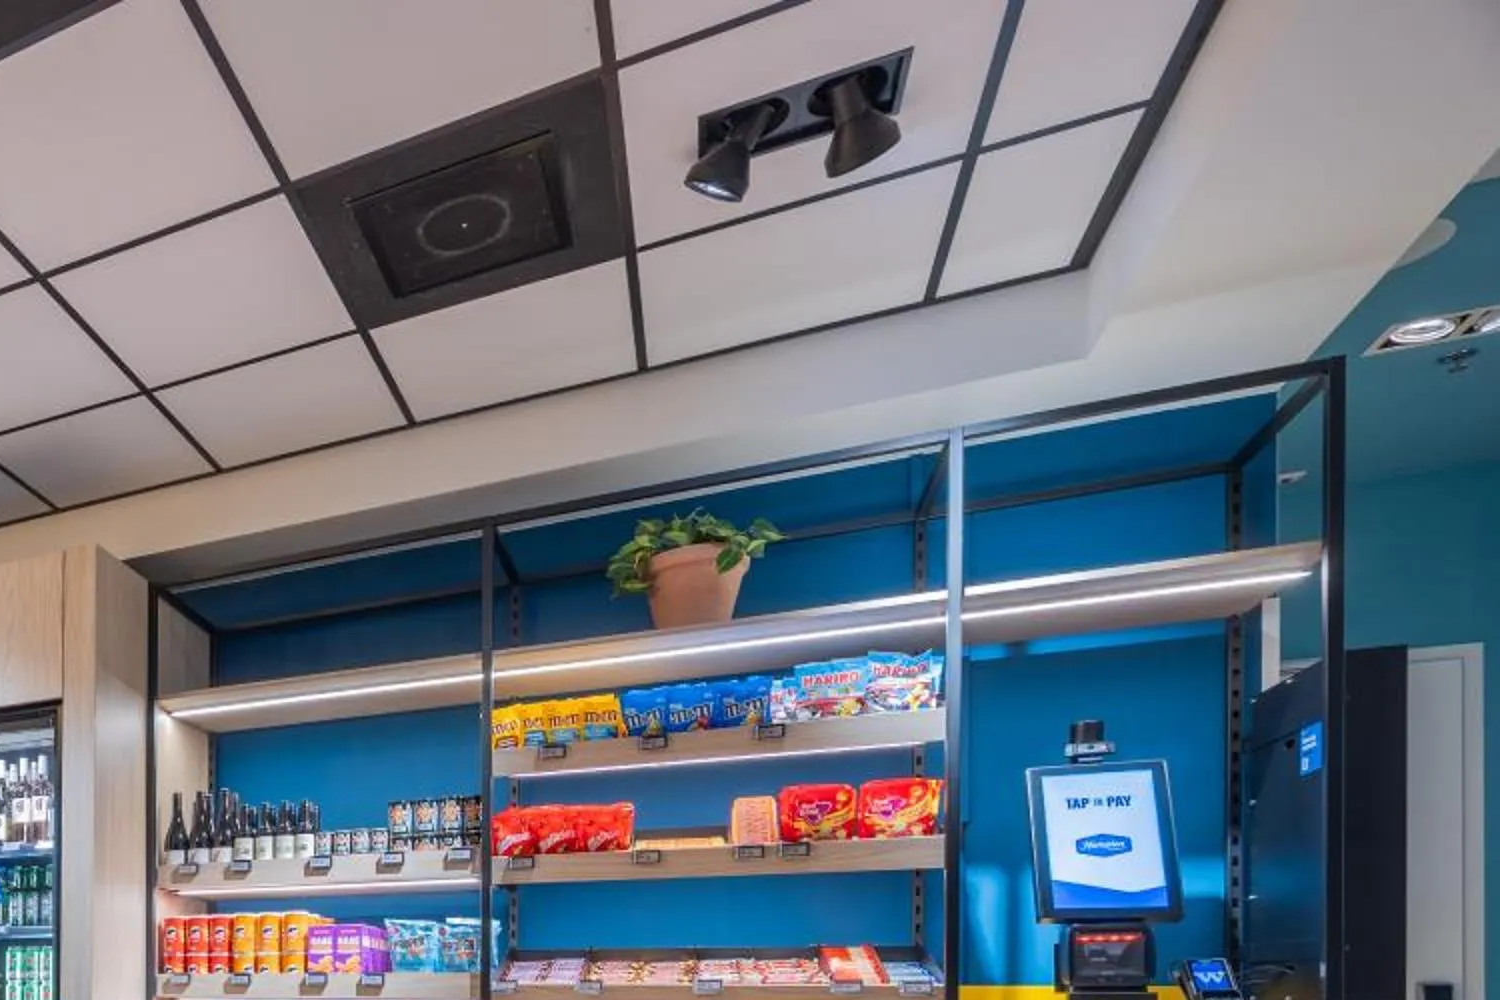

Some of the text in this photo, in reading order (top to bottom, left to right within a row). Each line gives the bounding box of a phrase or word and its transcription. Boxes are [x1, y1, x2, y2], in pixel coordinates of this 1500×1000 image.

[803, 671, 860, 687] HARIBO
[1066, 797, 1089, 810] TAP
[1106, 794, 1131, 808] PAY
